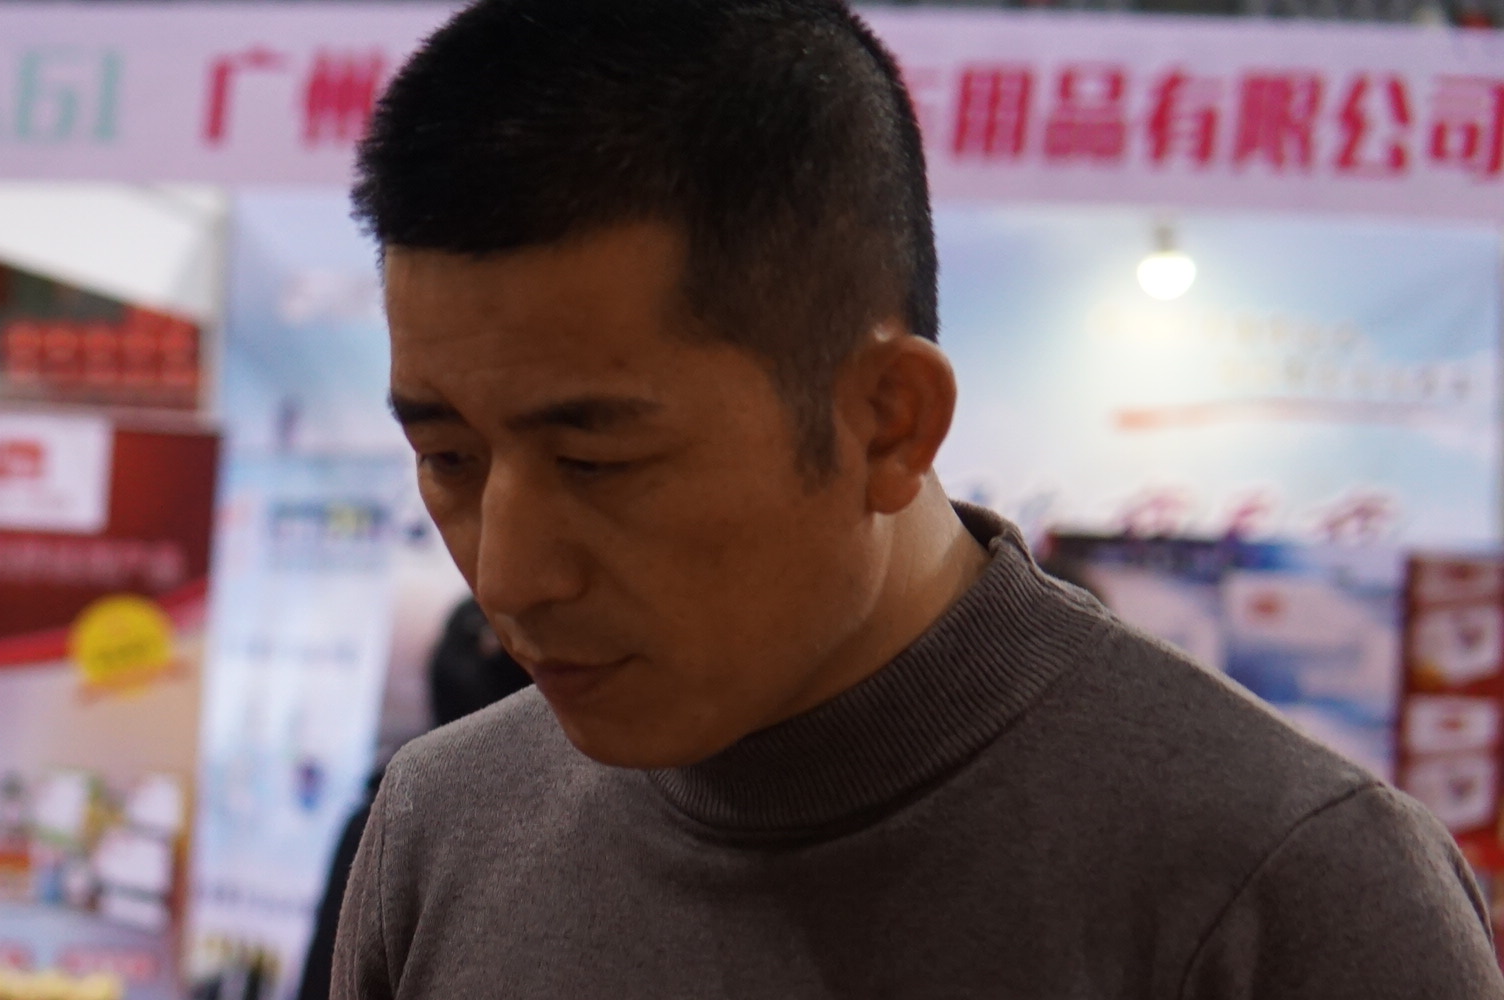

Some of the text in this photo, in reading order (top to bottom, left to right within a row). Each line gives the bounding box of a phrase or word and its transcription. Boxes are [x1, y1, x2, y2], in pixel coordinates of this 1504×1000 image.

[908, 64, 1504, 179] 用品有限公司
